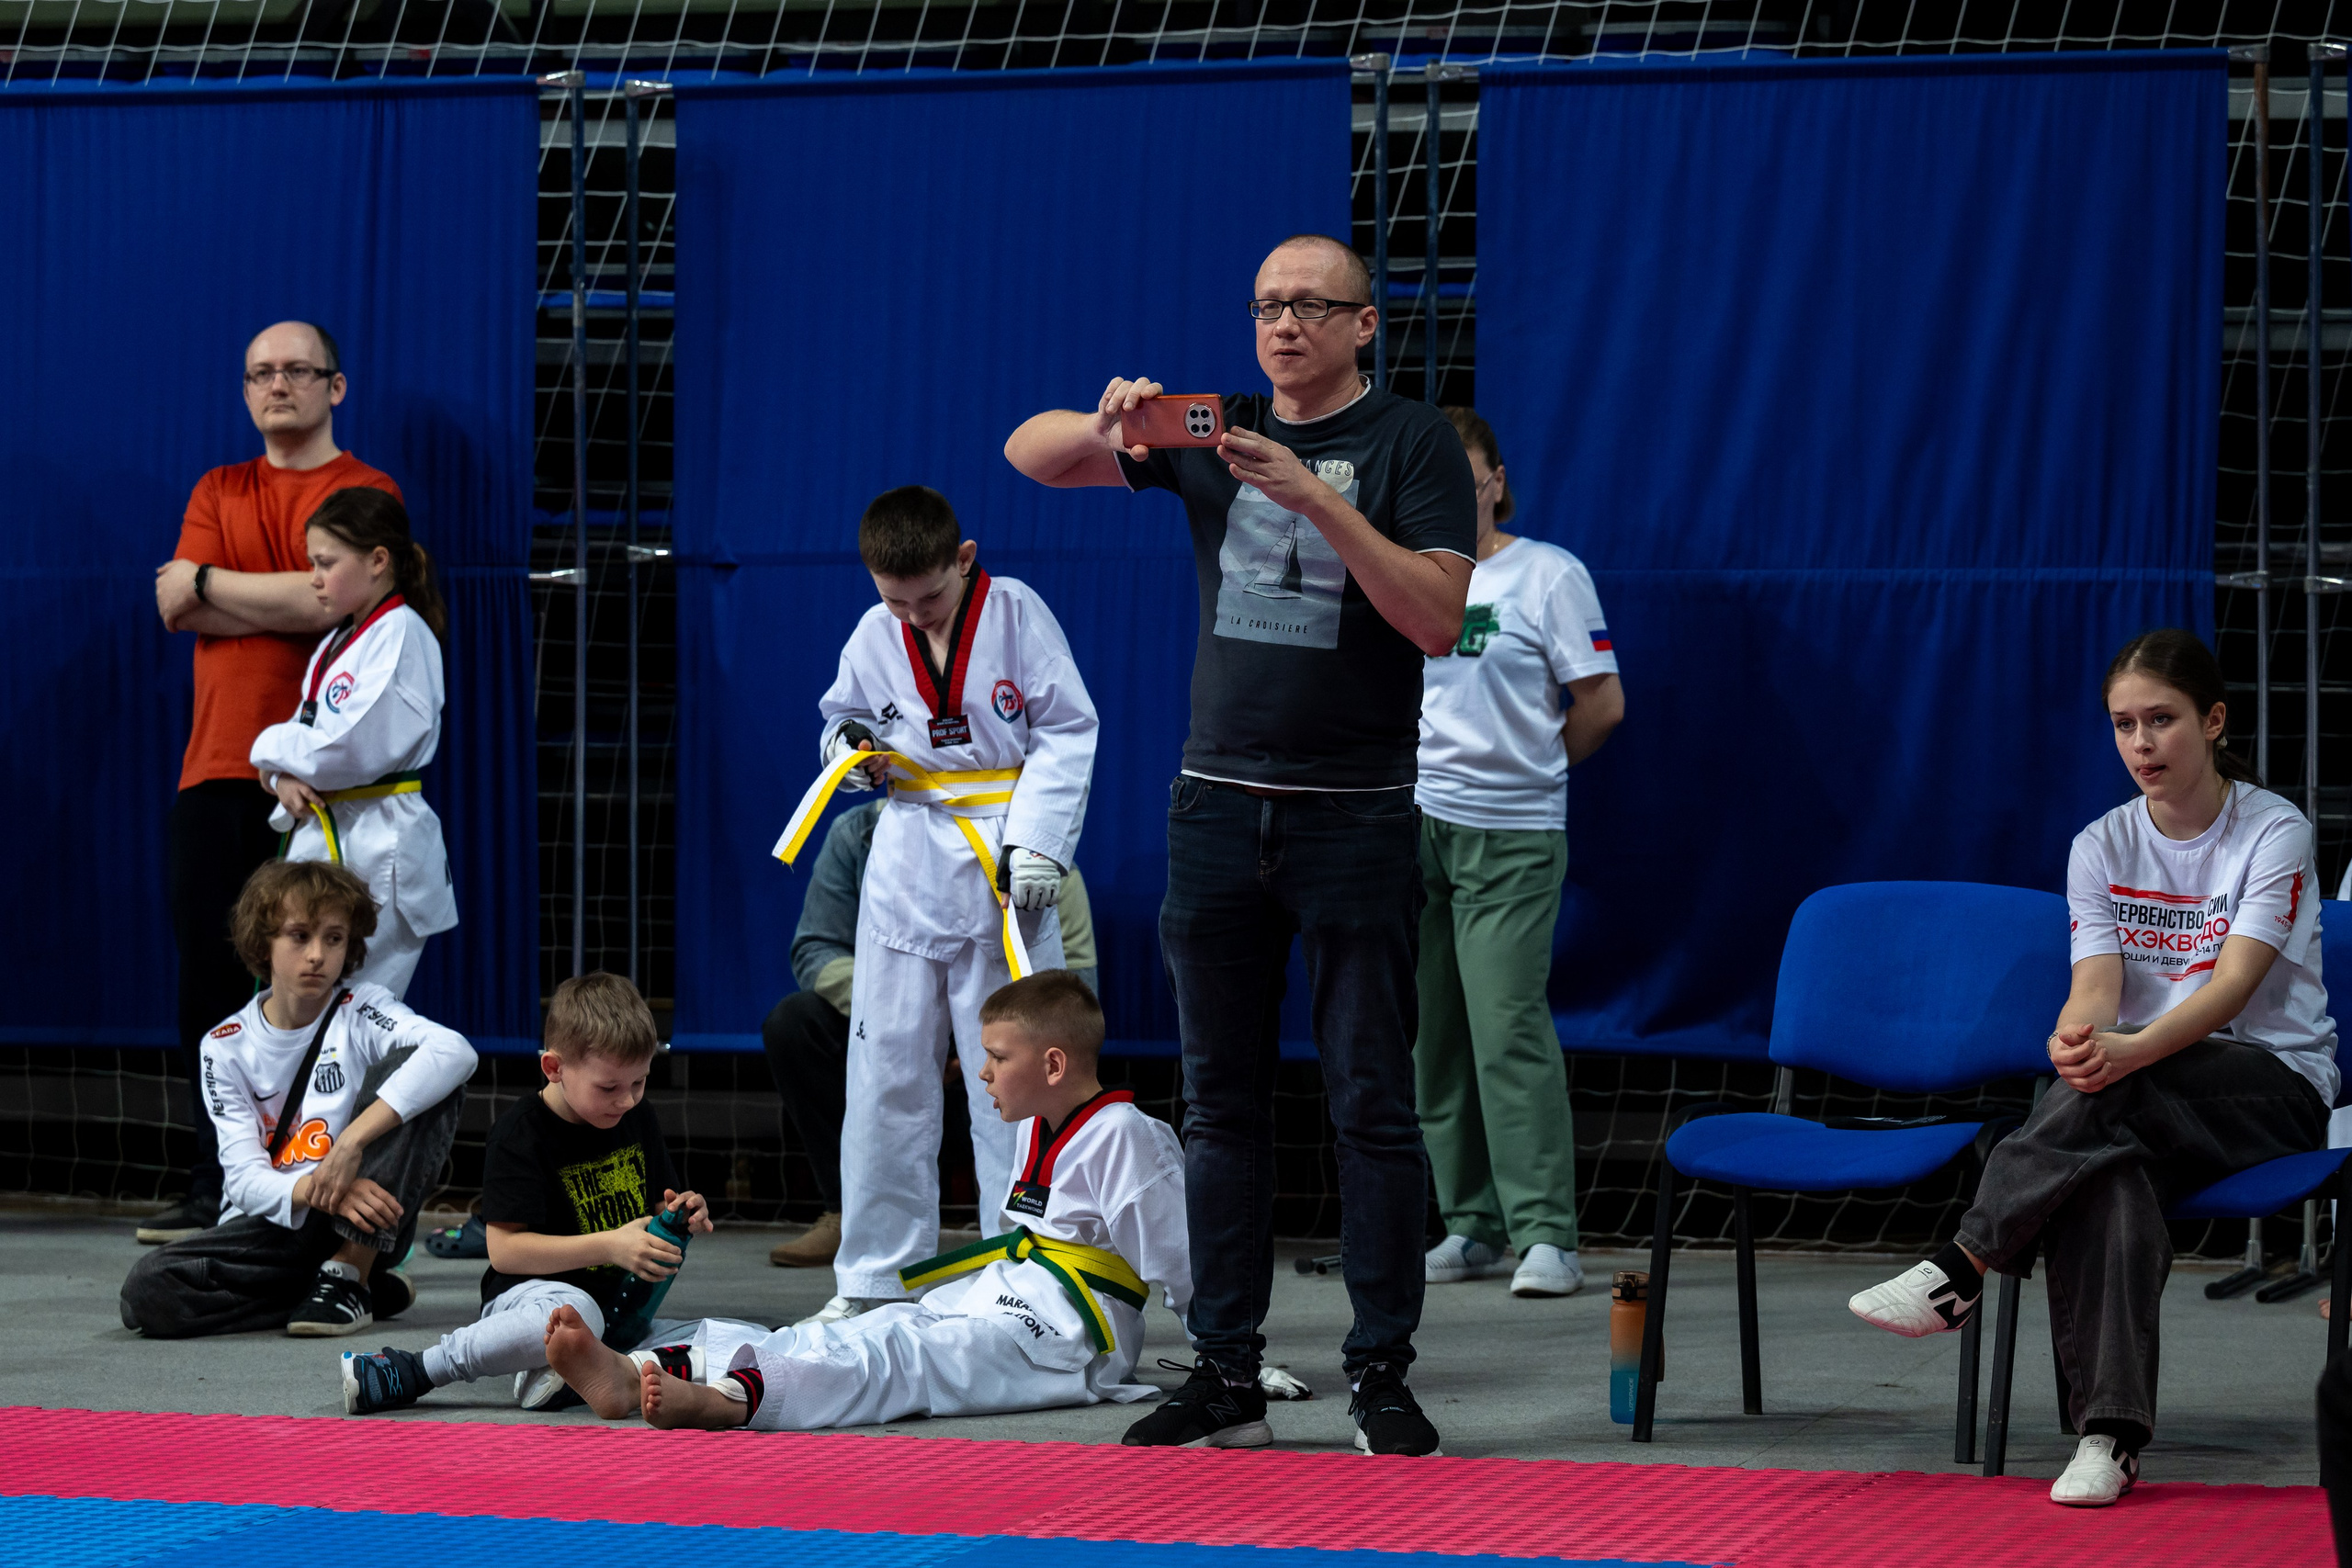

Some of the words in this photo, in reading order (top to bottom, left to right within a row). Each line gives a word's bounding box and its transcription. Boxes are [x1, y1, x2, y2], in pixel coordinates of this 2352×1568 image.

[1299, 458, 1354, 476] ANCES
[1230, 615, 1241, 626] LA
[1249, 619, 1308, 634] CROISIERE
[932, 728, 947, 738] PROF
[949, 725, 968, 736] SPORT
[2207, 893, 2228, 918] СИИ
[2152, 954, 2160, 964] И
[1016, 1202, 1045, 1214] TAEKWONDO
[1021, 1196, 1044, 1207] WORLD
